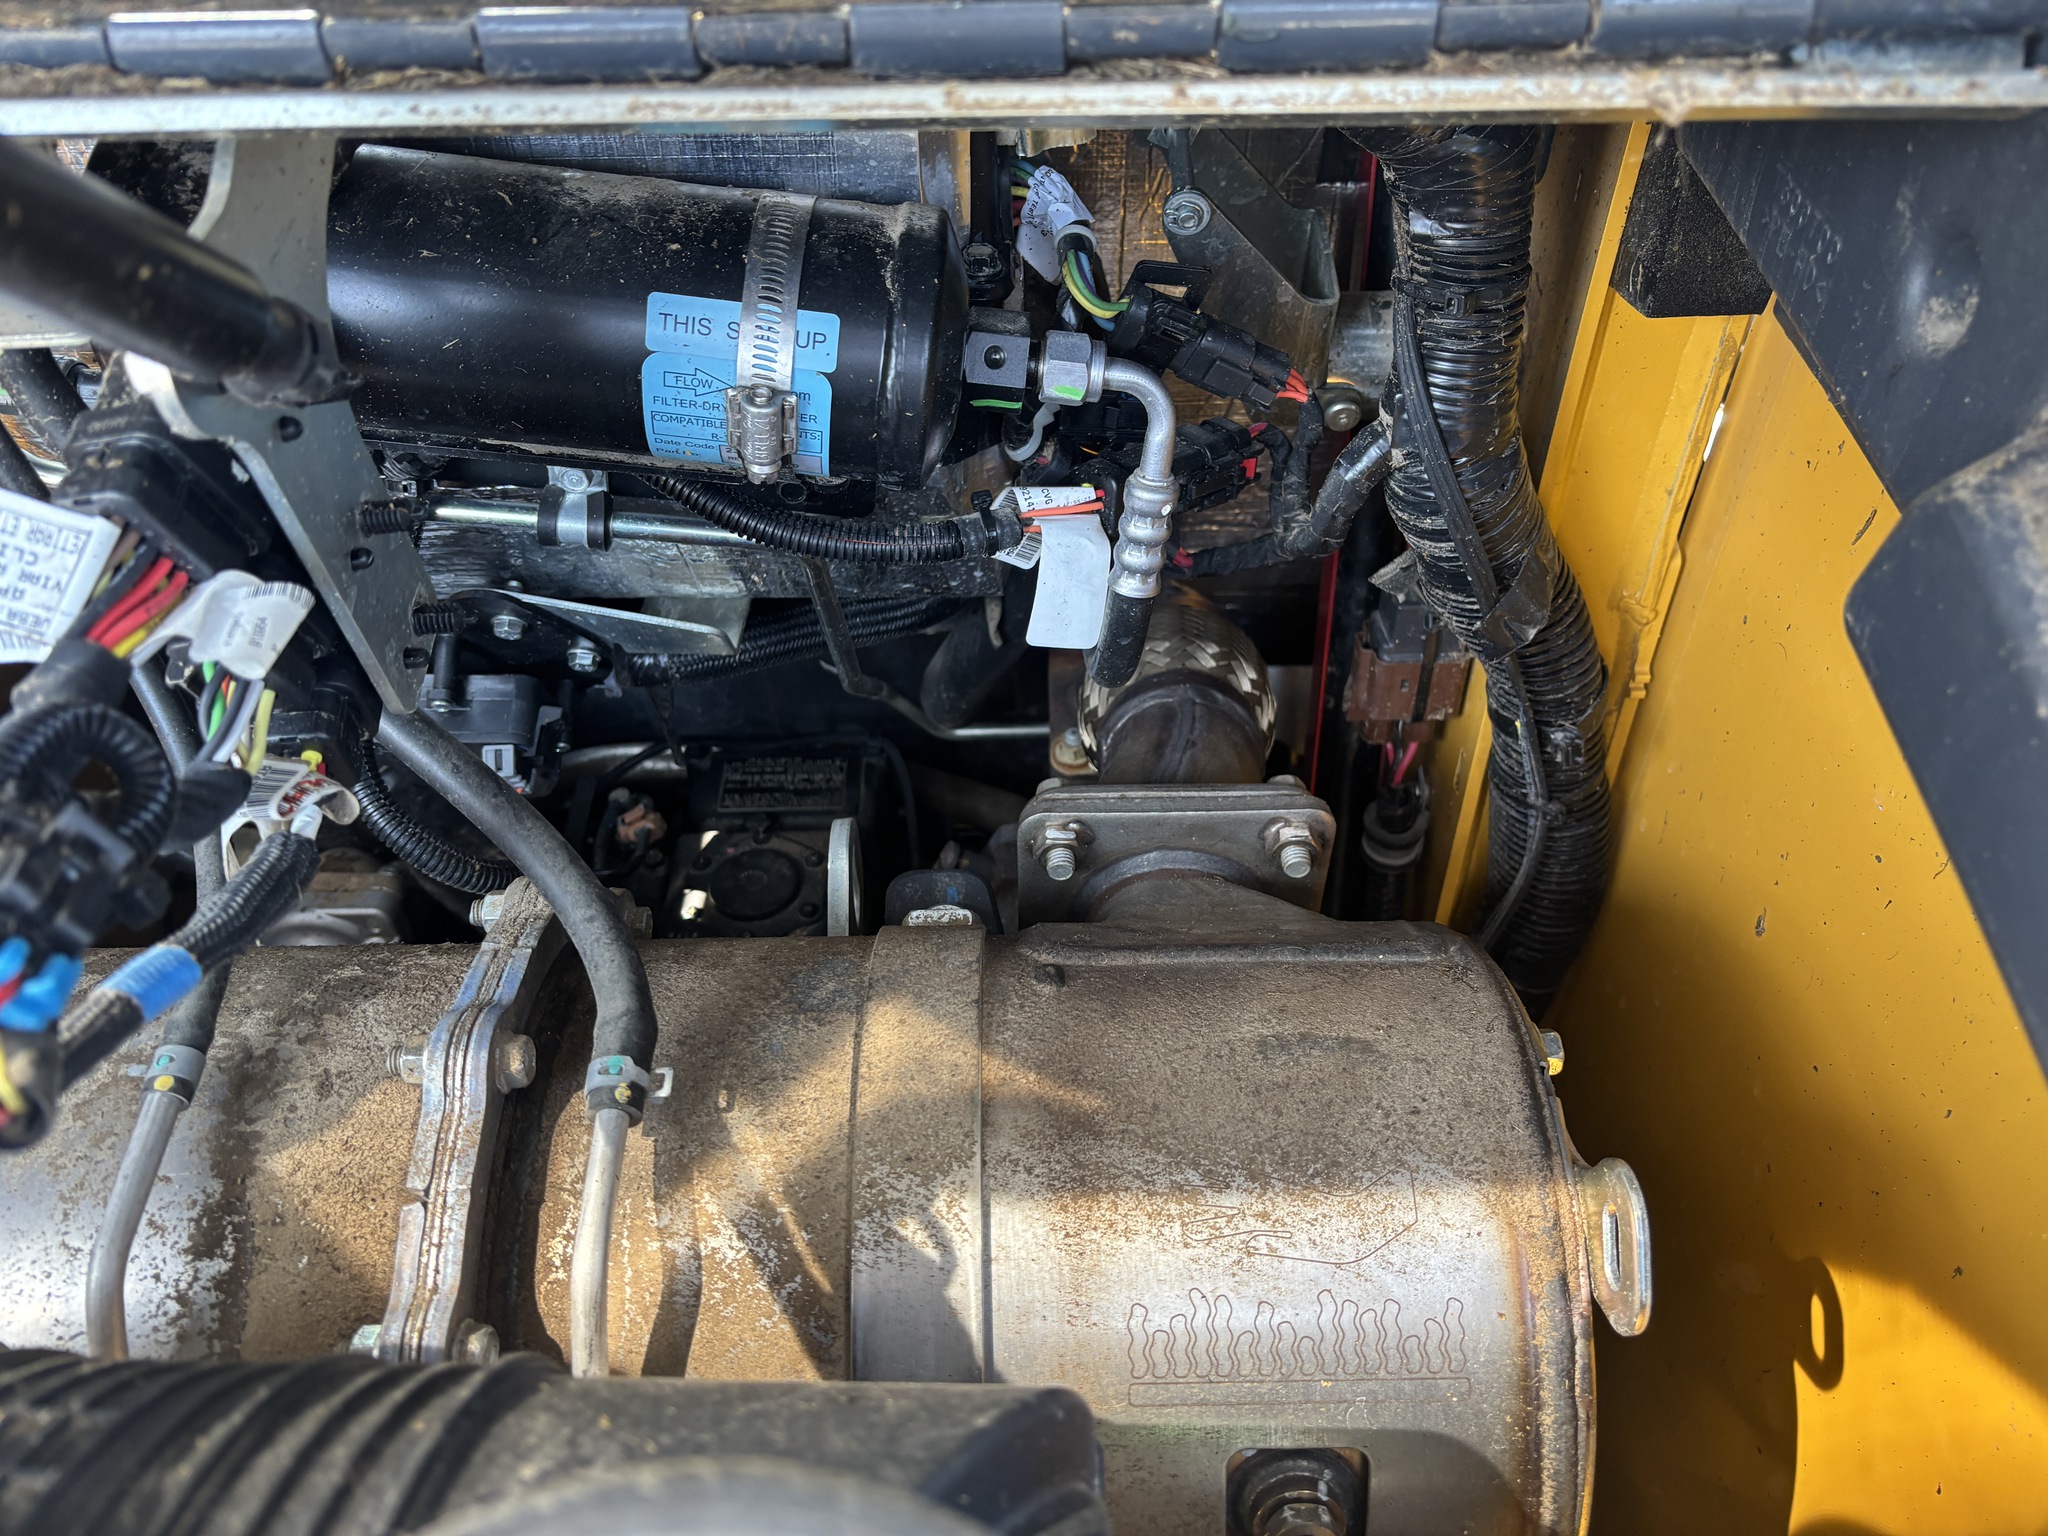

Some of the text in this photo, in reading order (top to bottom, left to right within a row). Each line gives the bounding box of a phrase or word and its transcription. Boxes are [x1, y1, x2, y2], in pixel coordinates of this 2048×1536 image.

[658, 312, 712, 336] THIS
[796, 330, 827, 350] UP
[673, 375, 713, 390] FLOW
[654, 437, 679, 447] Date
[689, 440, 718, 450] Code:
[1041, 488, 1053, 505] CVG
